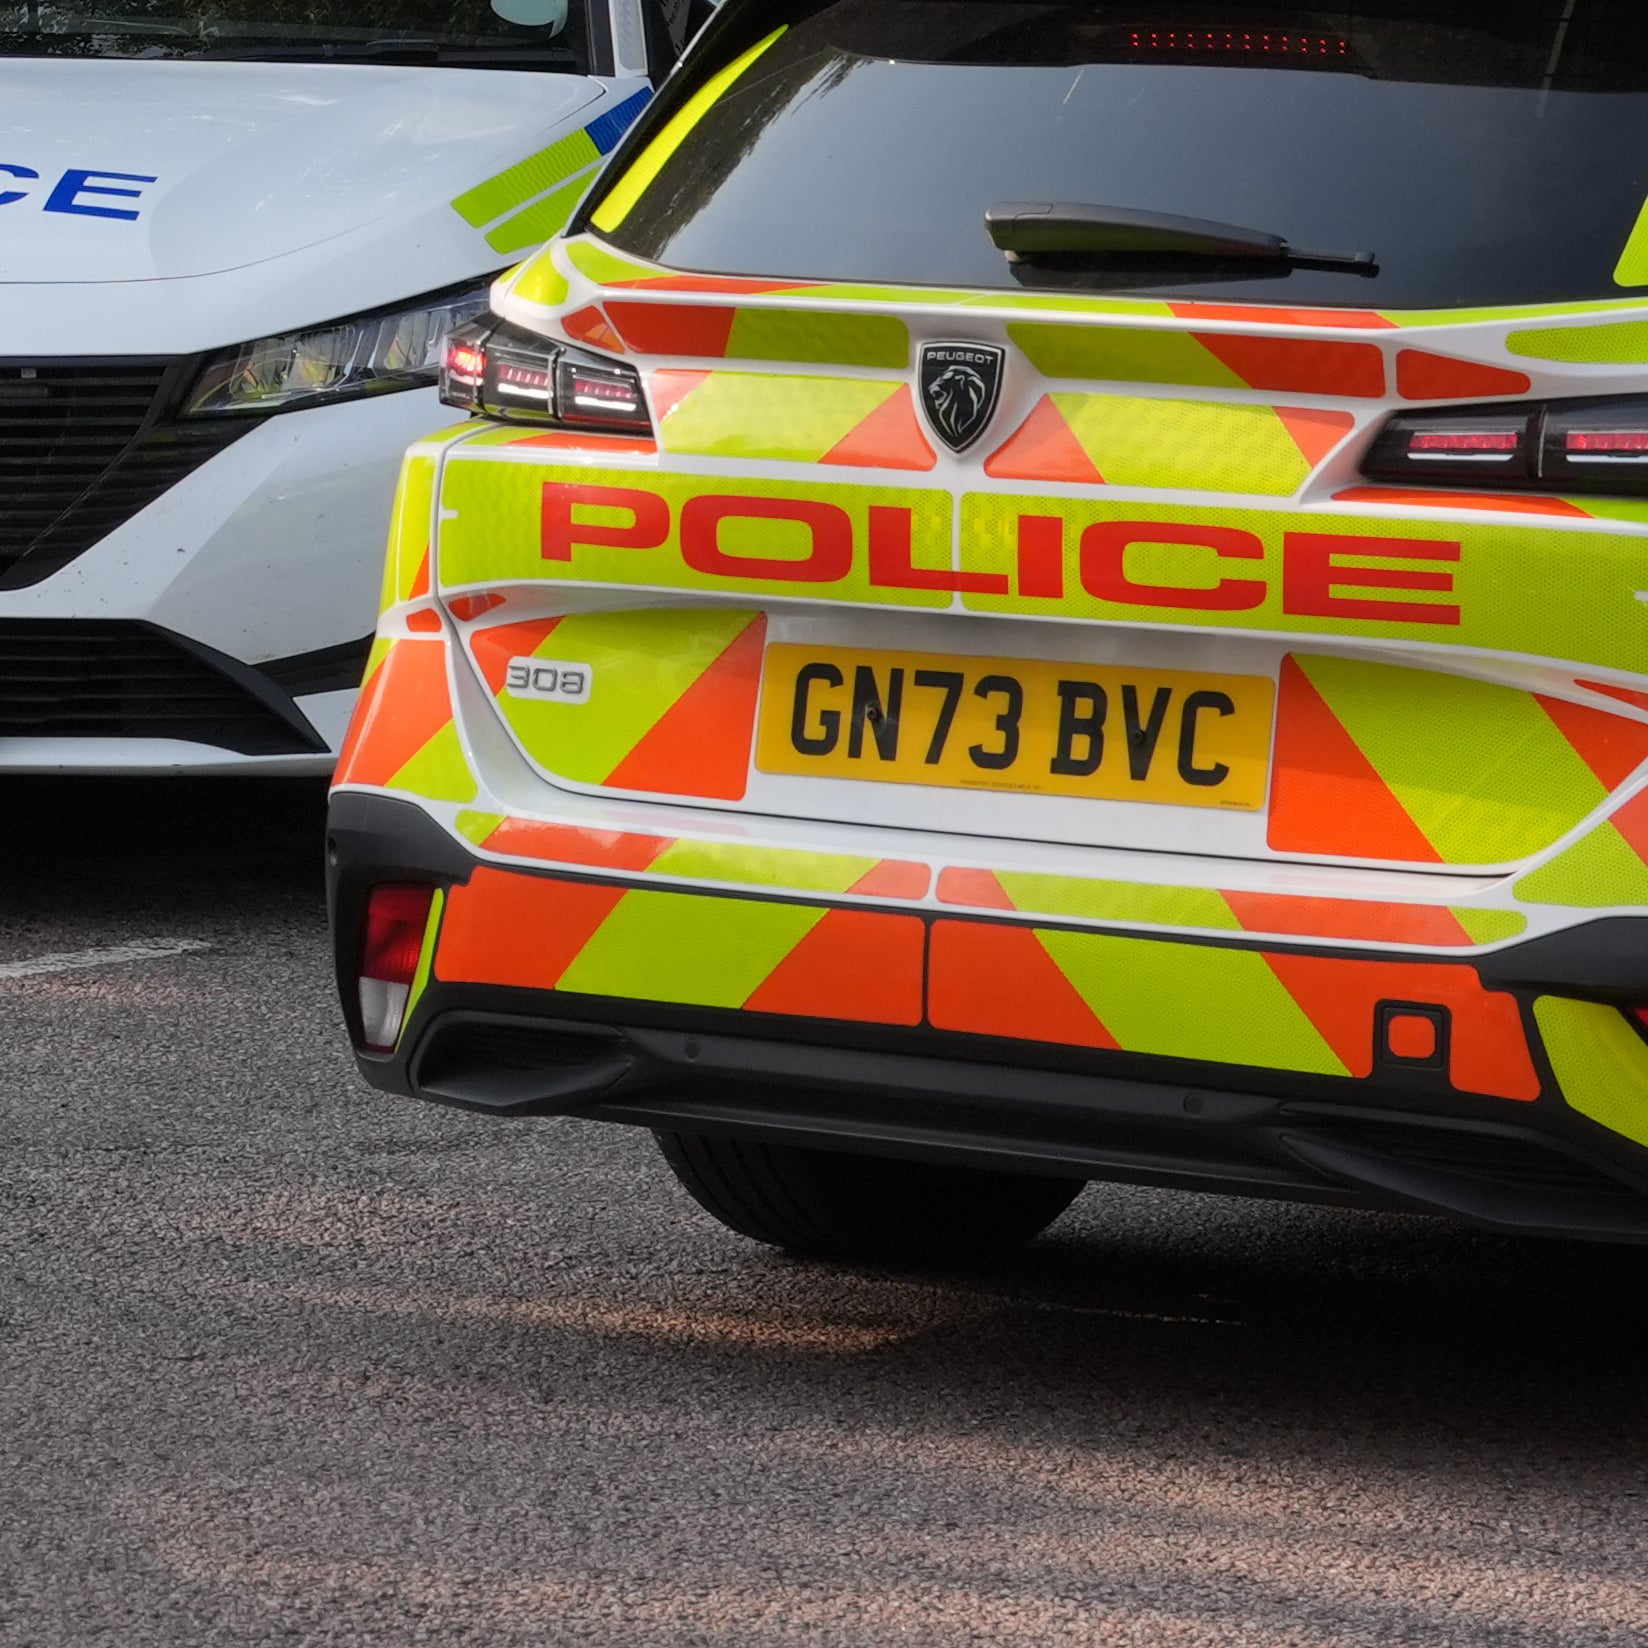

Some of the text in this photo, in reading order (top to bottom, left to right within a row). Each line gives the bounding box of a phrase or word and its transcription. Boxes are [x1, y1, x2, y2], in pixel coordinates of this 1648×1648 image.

[926, 349, 996, 366] PEUGEOT
[539, 480, 1463, 627] POLICE
[505, 663, 585, 694] 308
[789, 661, 1236, 788] GN73 BVC
